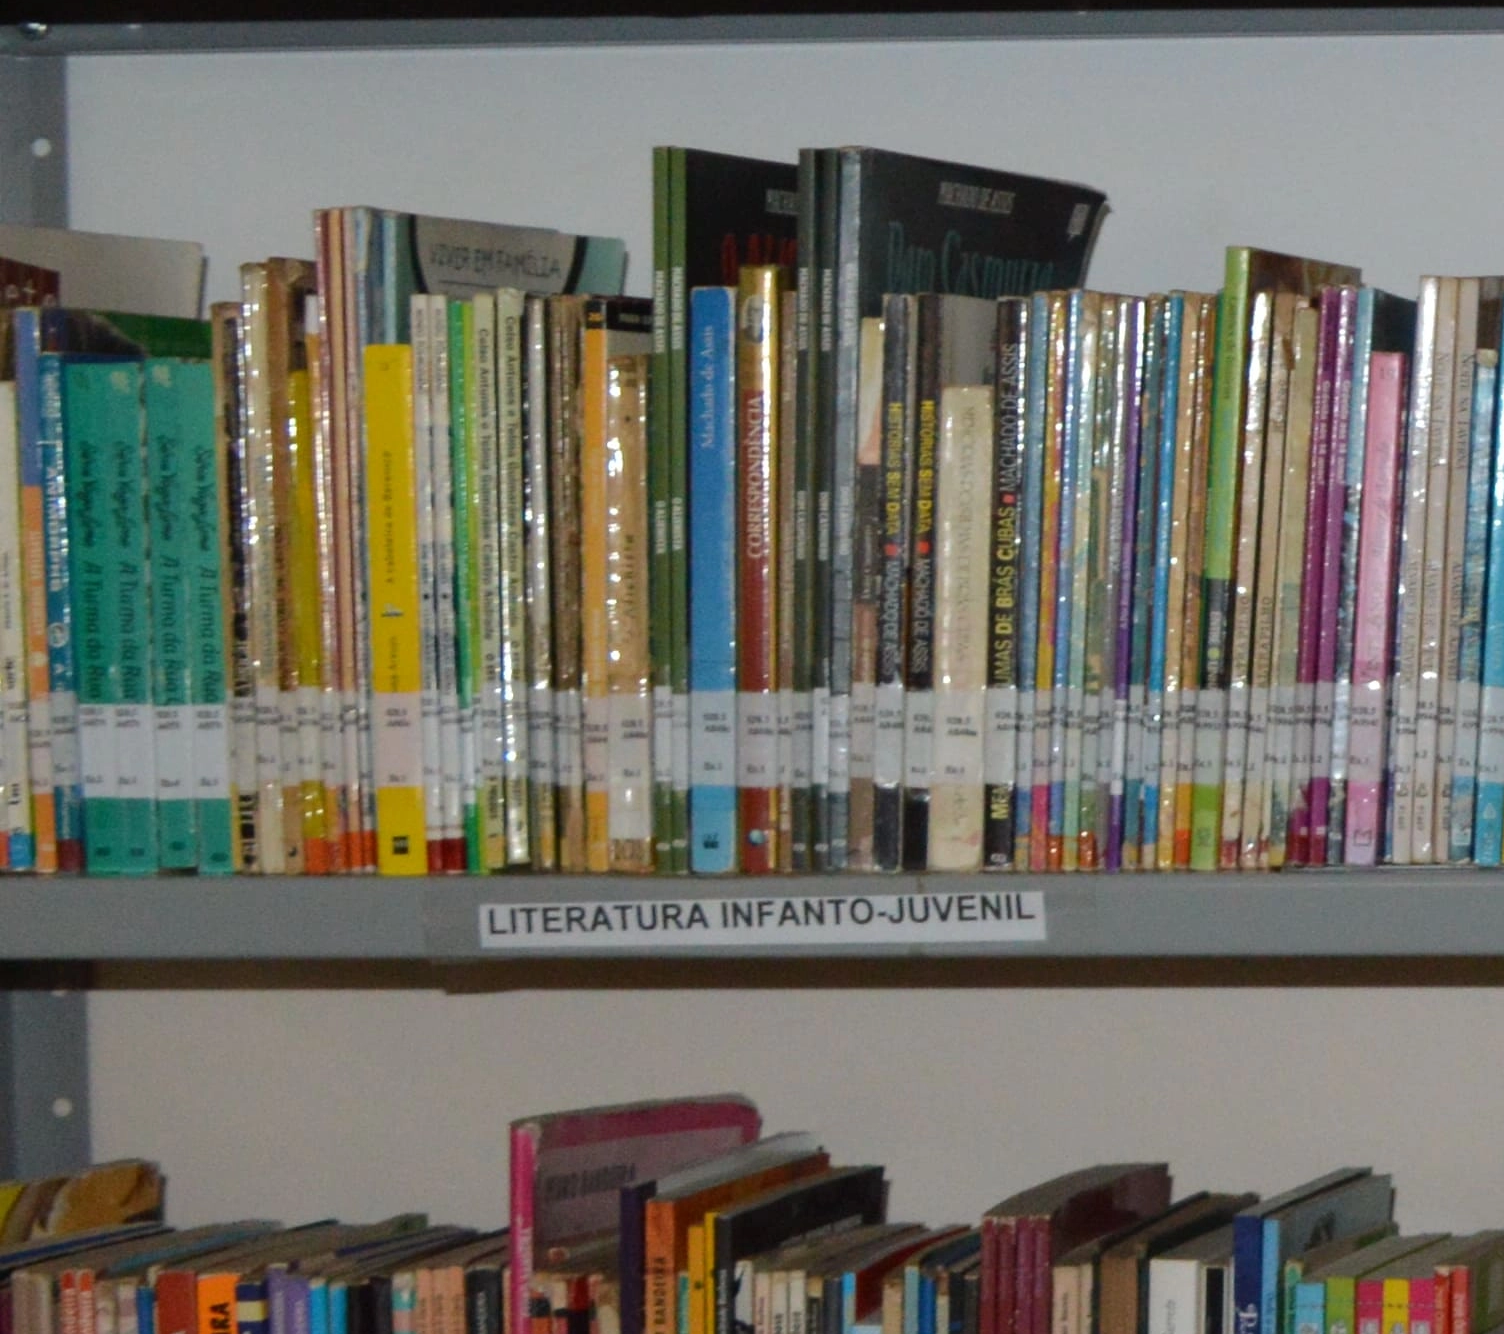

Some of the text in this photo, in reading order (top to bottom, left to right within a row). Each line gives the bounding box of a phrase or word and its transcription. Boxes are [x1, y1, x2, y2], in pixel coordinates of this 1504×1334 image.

[699, 325, 716, 448] Machado de Assis
[1002, 343, 1018, 387] ASSIS
[1002, 394, 1017, 410] DE
[743, 395, 764, 558] CORRESPONDÊNCIA
[999, 416, 1018, 491] MACHADO
[993, 506, 1013, 561] CUBAS
[991, 565, 1013, 608] BRÁS
[995, 613, 1013, 635] DE
[489, 893, 1036, 934] LITERATURA INFANTO-JUVENIL
[651, 1256, 667, 1325] BANDEIRA
